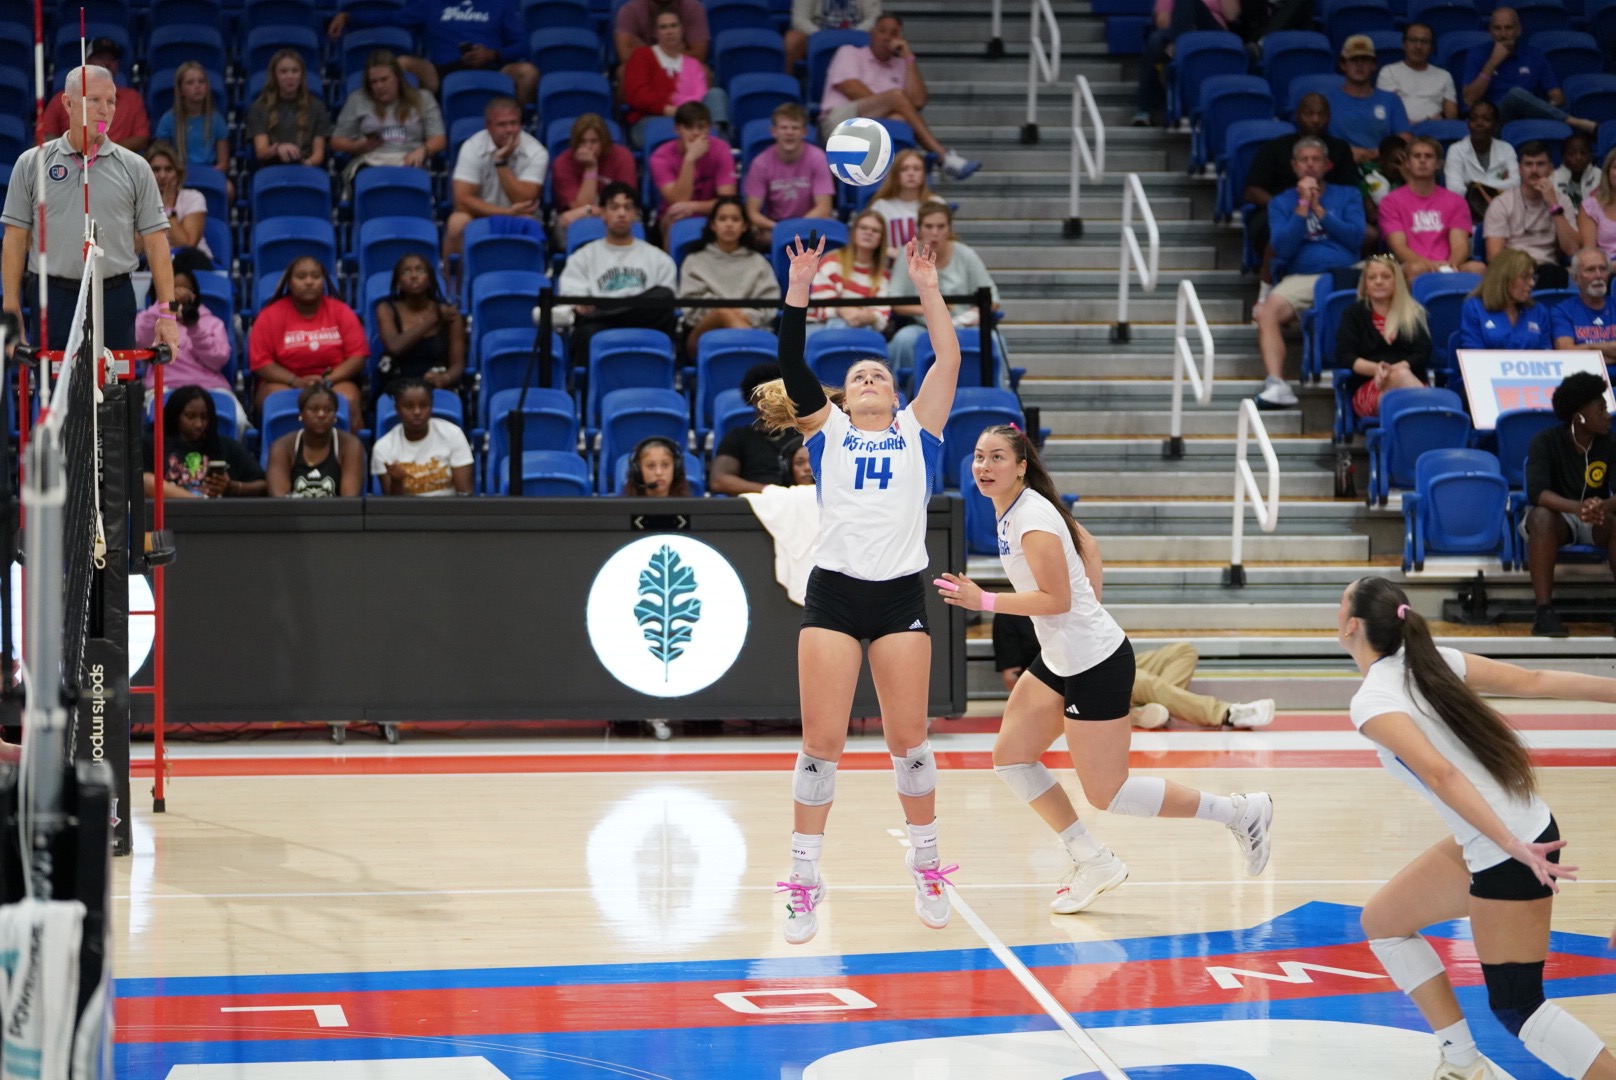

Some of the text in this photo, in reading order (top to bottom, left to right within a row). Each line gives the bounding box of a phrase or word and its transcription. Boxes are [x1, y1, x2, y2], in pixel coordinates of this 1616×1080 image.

[1500, 361, 1563, 377] POINT
[1495, 386, 1557, 411] WES
[854, 456, 894, 490] 14
[90, 664, 106, 766] sports impor
